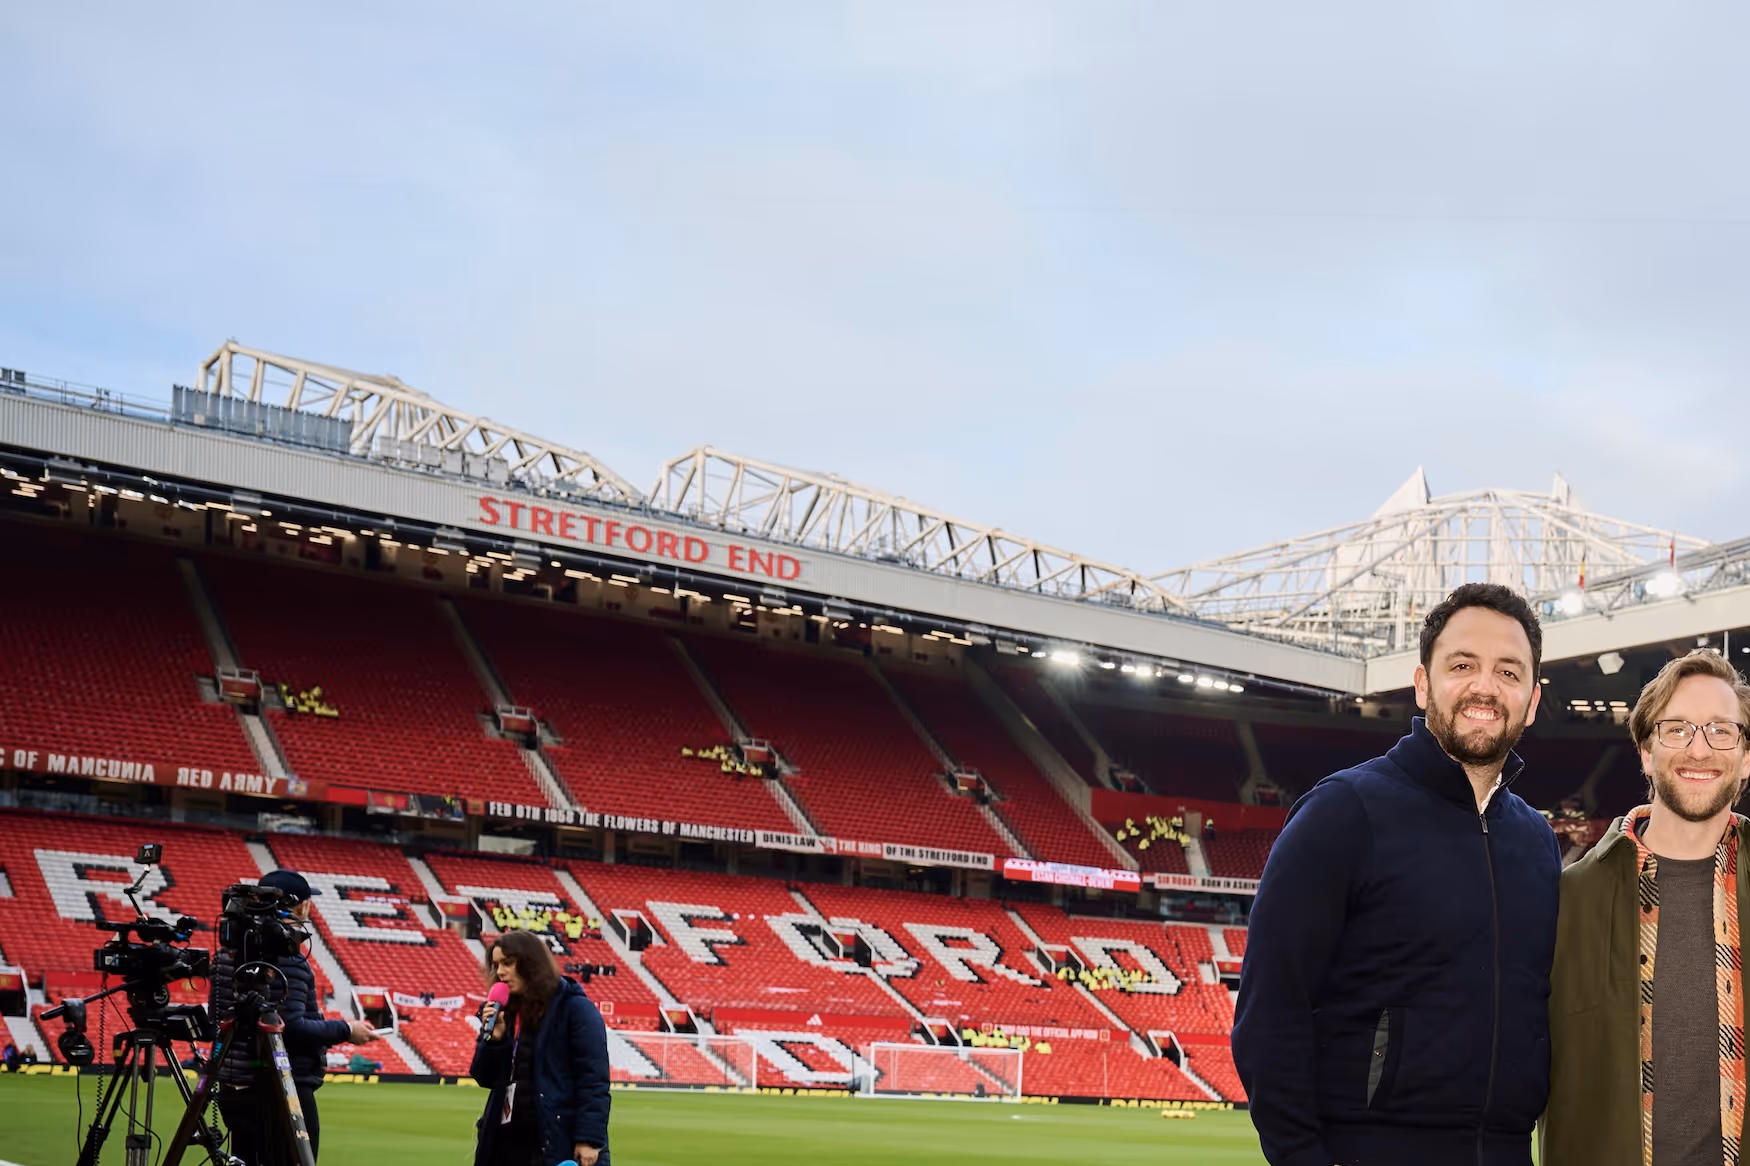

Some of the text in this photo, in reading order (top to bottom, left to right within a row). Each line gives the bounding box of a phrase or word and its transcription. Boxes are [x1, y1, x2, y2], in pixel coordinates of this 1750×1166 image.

[479, 495, 802, 581] STRETFORD END
[14, 749, 38, 769] OF
[579, 812, 600, 827] THE
[604, 814, 659, 833] FLOWERS
[662, 821, 676, 836] OF
[680, 822, 754, 843] MANCHESTER
[763, 832, 792, 846] DENIS
[794, 836, 816, 848] LAW
[886, 845, 897, 855] OF
[900, 846, 916, 858] THE
[919, 848, 969, 864] STRETFORD
[972, 853, 988, 866] END
